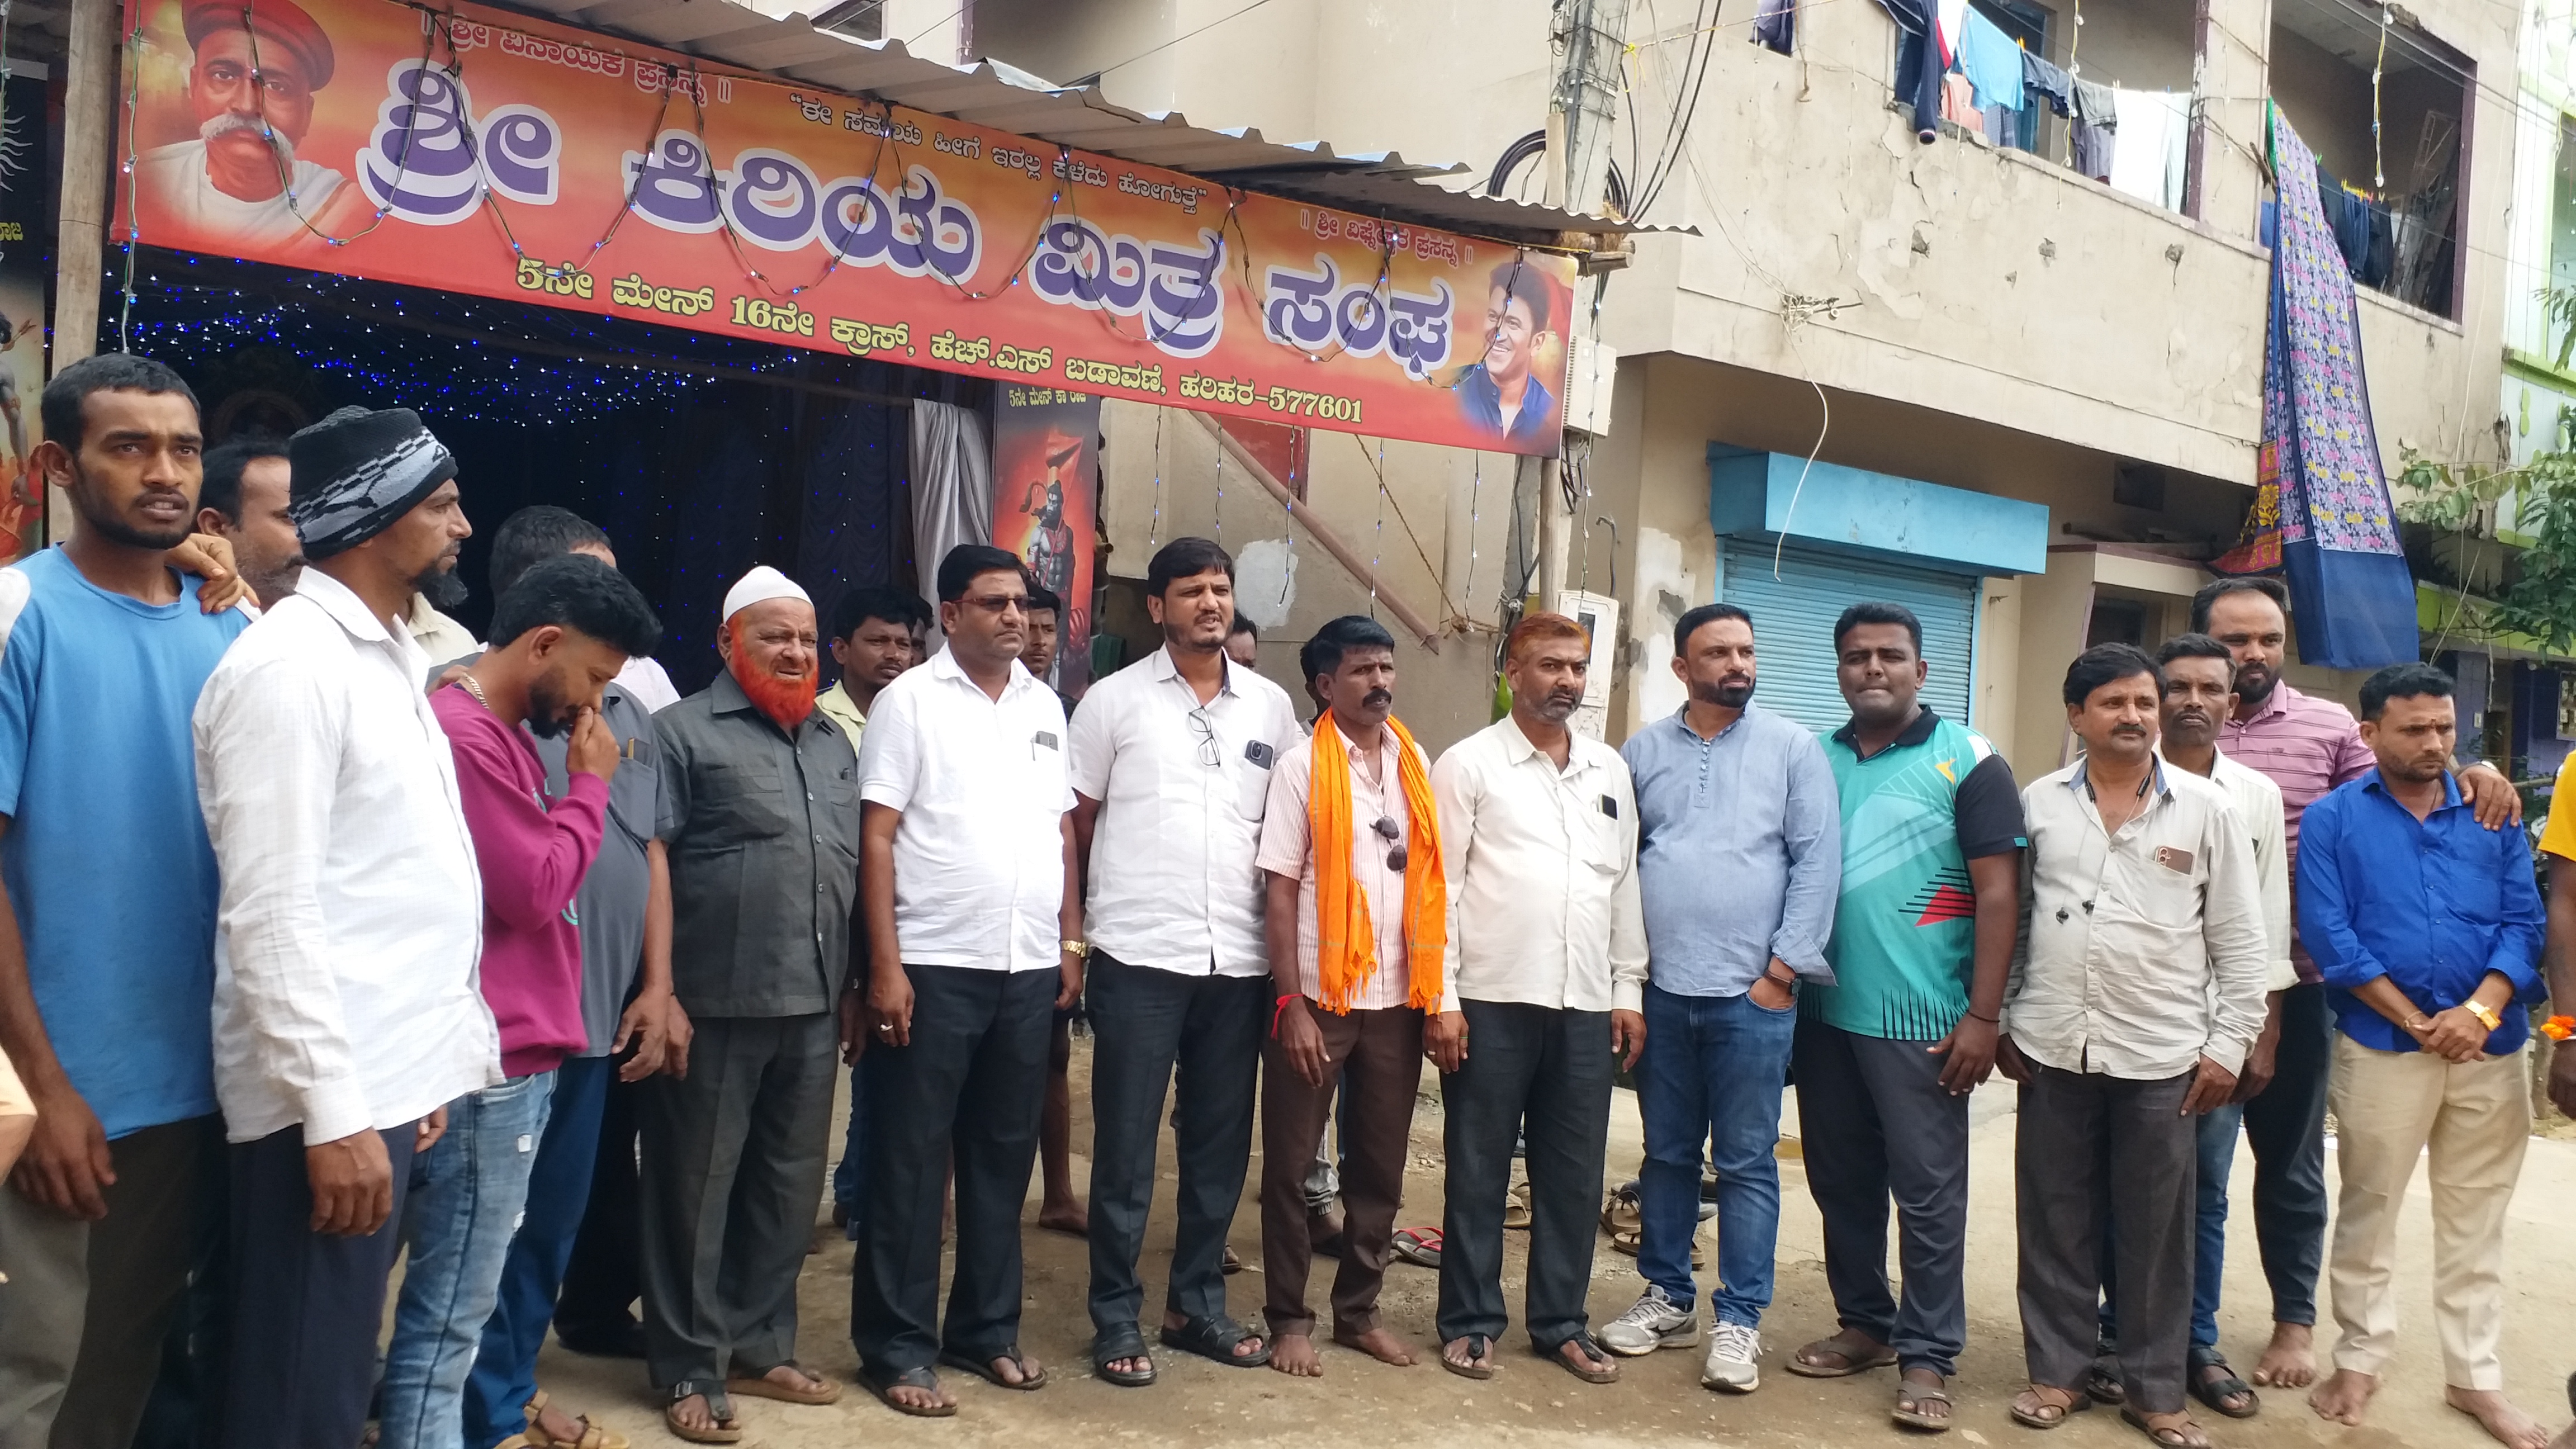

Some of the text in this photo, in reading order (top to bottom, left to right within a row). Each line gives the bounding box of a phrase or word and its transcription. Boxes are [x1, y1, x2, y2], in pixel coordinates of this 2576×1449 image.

[501, 31, 623, 75] ವಿನಾಯಕ
[844, 108, 922, 145] ಸಮಯ
[933, 131, 982, 159] ಹೀಗೆ
[991, 146, 1041, 181] ಇರಲ್ಲ
[363, 65, 1451, 376] ಶ್ರೀ ಕಿರಿಯ ಮಿತ್ರ ಸಂಘ
[1315, 212, 1338, 238] ಶ್ರೀ
[1417, 236, 1457, 267] ಪ್ರಸನ್ನ
[517, 258, 593, 299] 5ನೇ
[612, 274, 714, 315] ಮೇನ್
[730, 295, 815, 337] 16ನೇ
[830, 317, 916, 356] ಕ್ರಾಸ್,
[1065, 357, 1167, 395] ಬಡಾವಣೆ,
